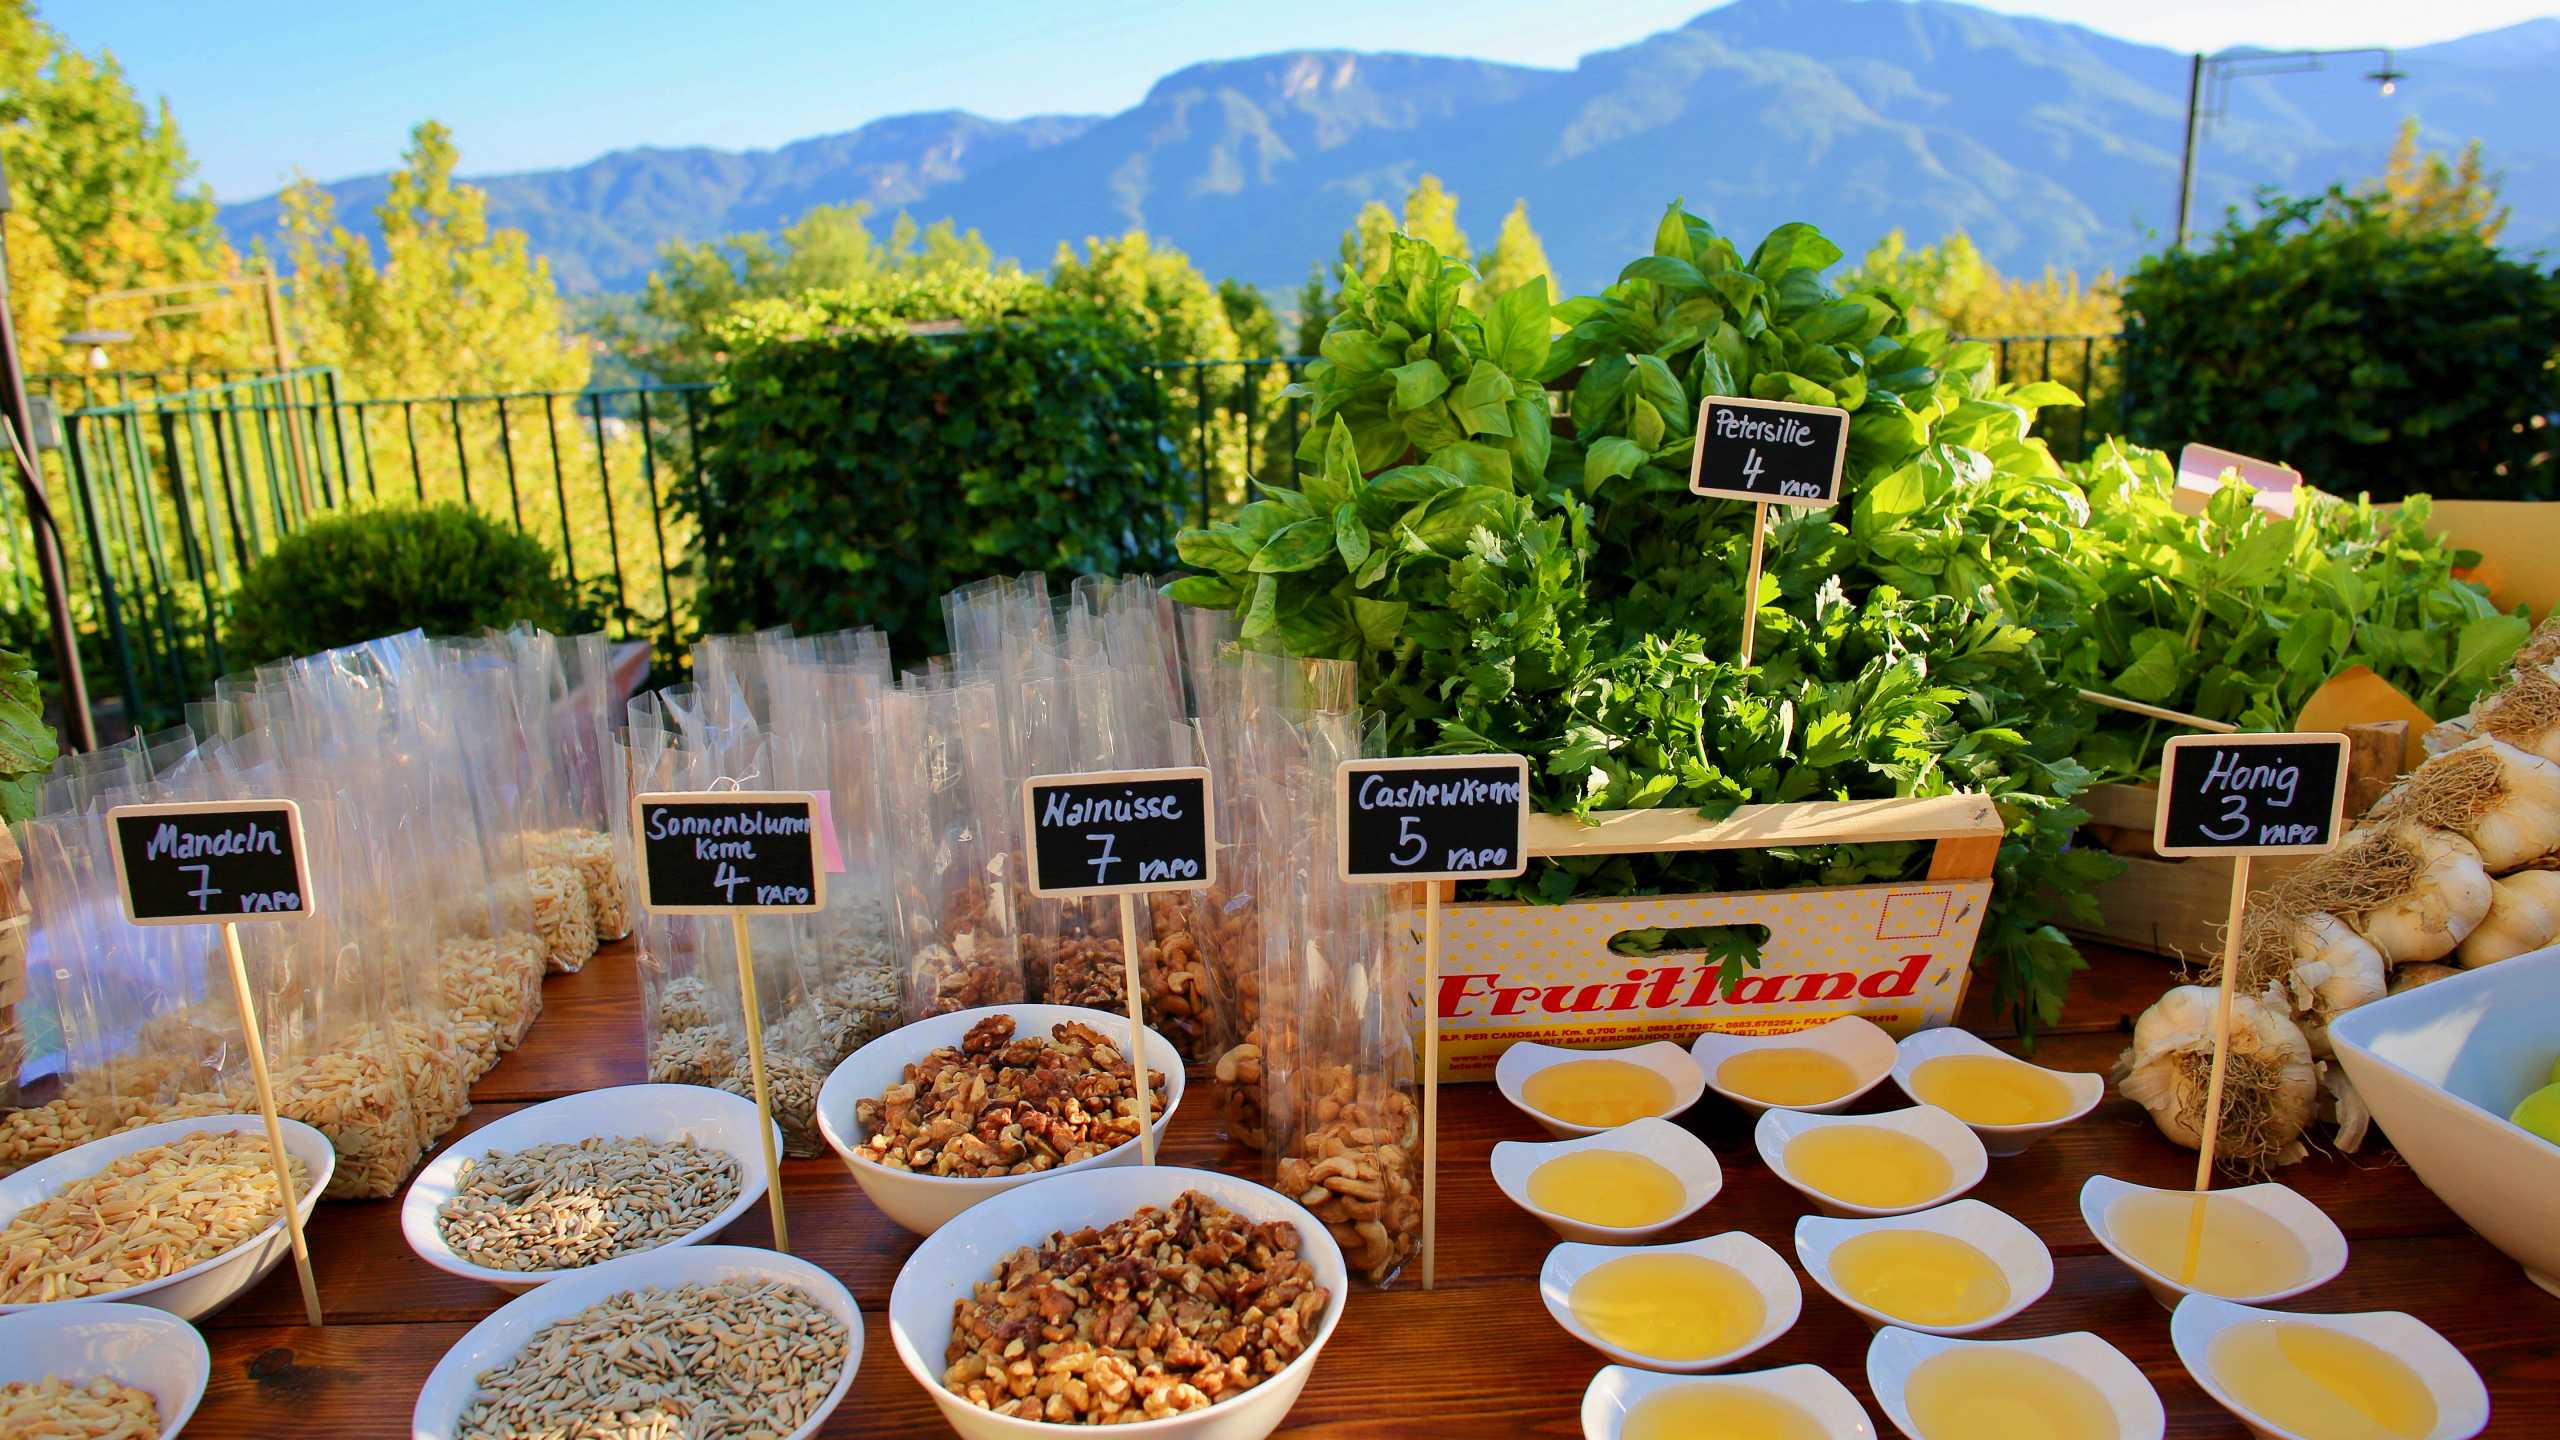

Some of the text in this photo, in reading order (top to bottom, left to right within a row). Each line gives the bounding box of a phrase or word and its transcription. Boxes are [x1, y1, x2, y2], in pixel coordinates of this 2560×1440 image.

[1716, 409, 1816, 447] Petersilie
[1743, 448, 1766, 489] 4
[2200, 750, 2299, 807] Honig
[2199, 795, 2250, 840] 3
[146, 822, 282, 861] Mandeln
[1086, 834, 1121, 884] 7
[1390, 816, 1428, 866] 5
[178, 864, 222, 911] 7
[713, 862, 750, 903] 4
[1438, 954, 1932, 1018] Fruitland
[1464, 1032, 1489, 1041] PER
[1543, 1029, 1558, 1037] AL
